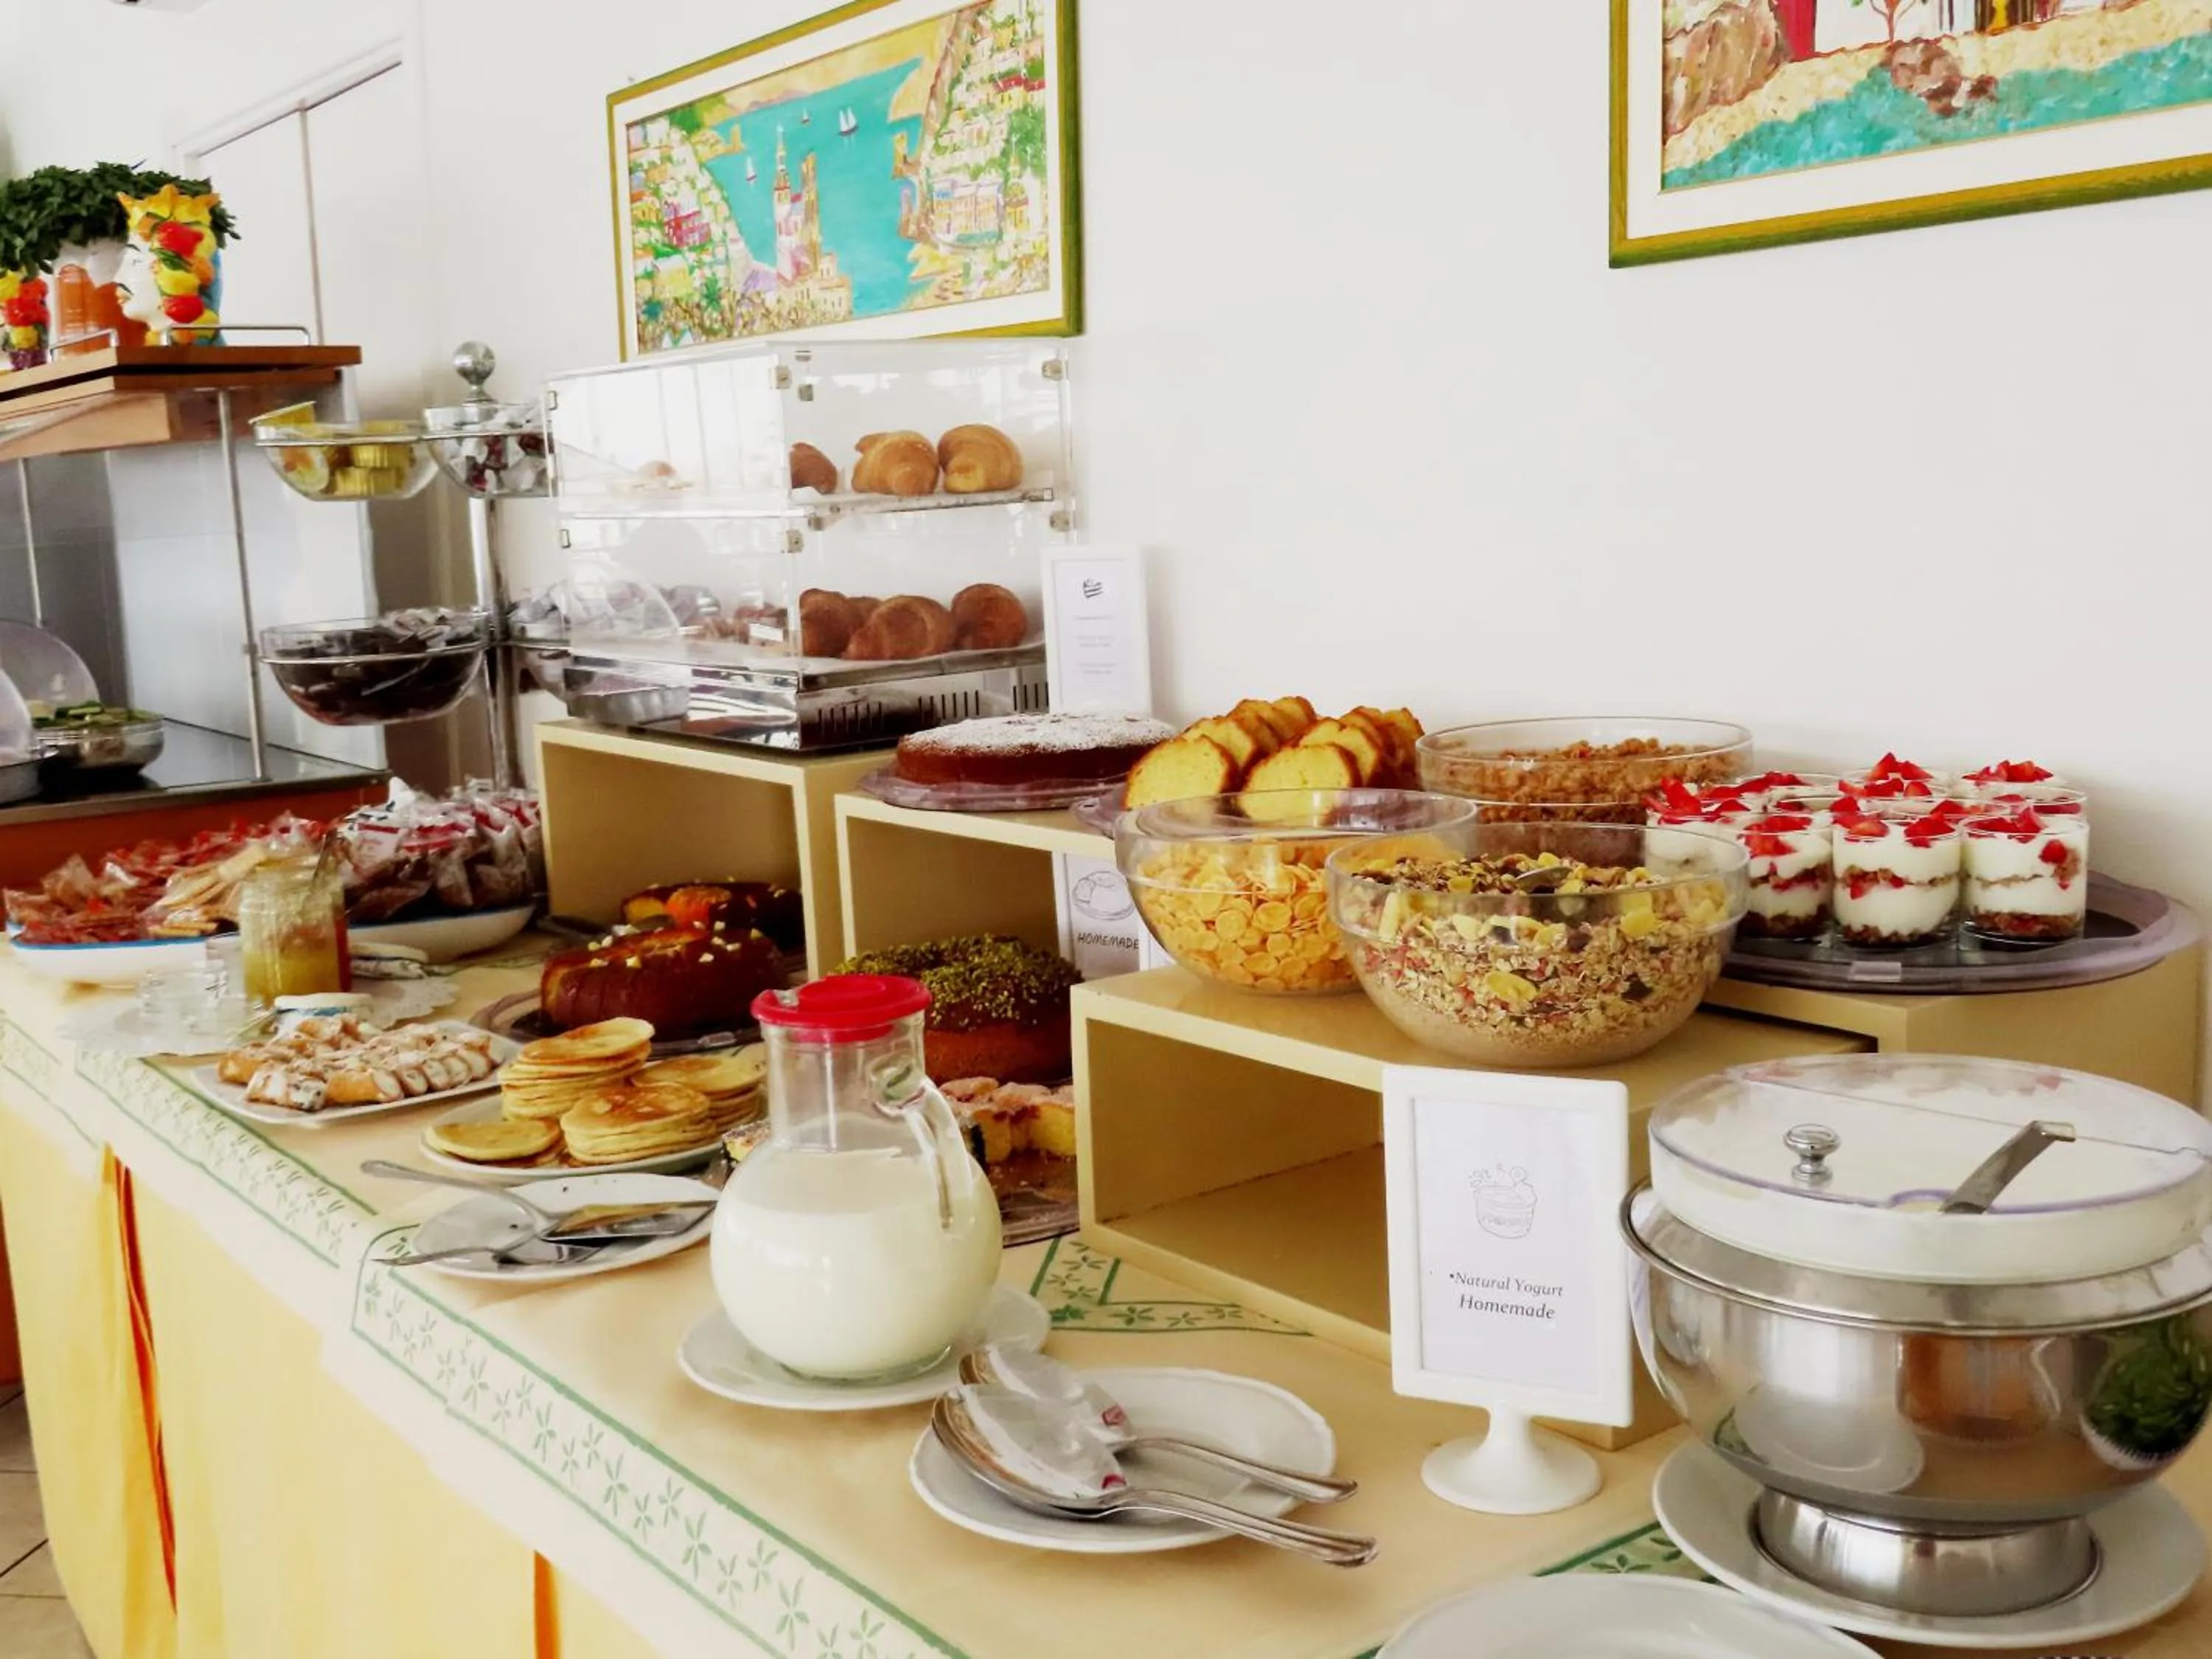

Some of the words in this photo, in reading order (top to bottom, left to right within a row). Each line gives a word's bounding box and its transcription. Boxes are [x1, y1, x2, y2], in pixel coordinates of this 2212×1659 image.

[1077, 932, 1139, 949] HOMEMADE
[1514, 1278, 1563, 1296] Yogurt
[1459, 1293, 1556, 1319] Homemade
